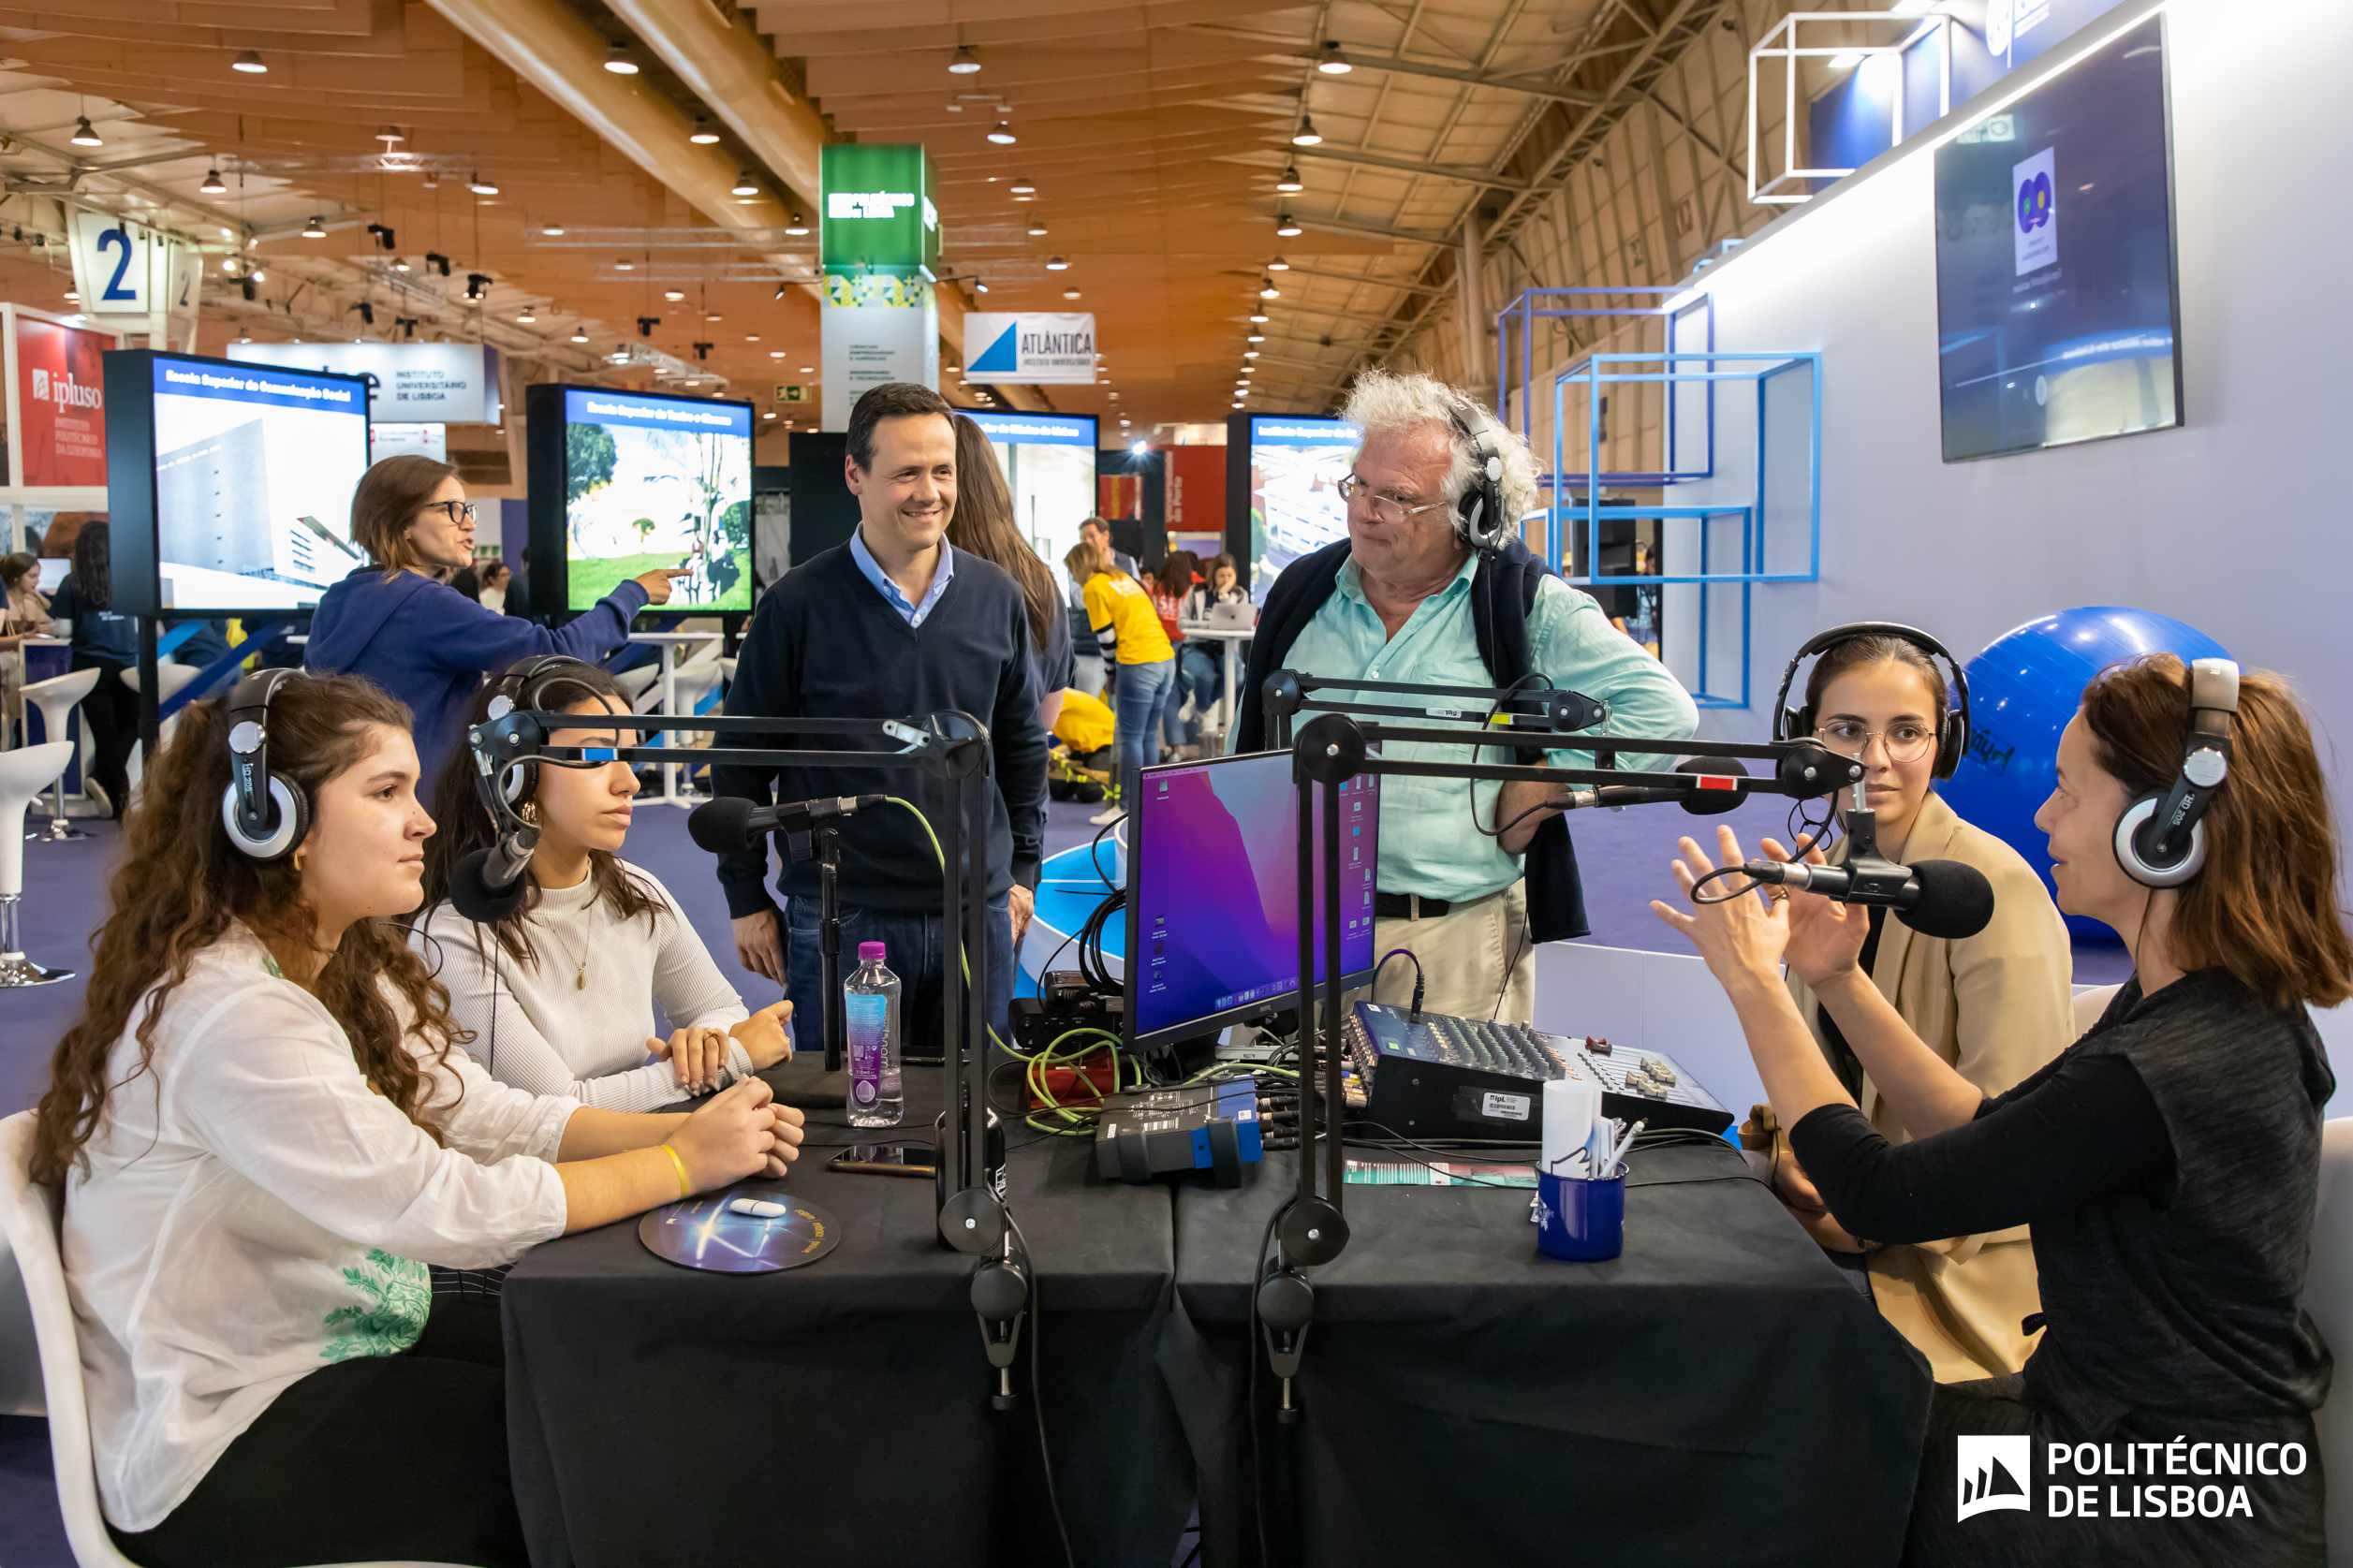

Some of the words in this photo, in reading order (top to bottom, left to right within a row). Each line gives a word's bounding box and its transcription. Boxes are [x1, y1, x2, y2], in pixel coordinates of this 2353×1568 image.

[97, 228, 137, 300] 2
[1022, 330, 1092, 354] ATLÂNTICA
[396, 371, 445, 379] INSTITUTO
[396, 380, 467, 389] UNIVERSITÁRIO
[52, 372, 102, 414] ipluso
[243, 763, 253, 776] HD
[244, 777, 253, 792] 205
[2181, 794, 2194, 810] HD
[2172, 811, 2185, 827] 205
